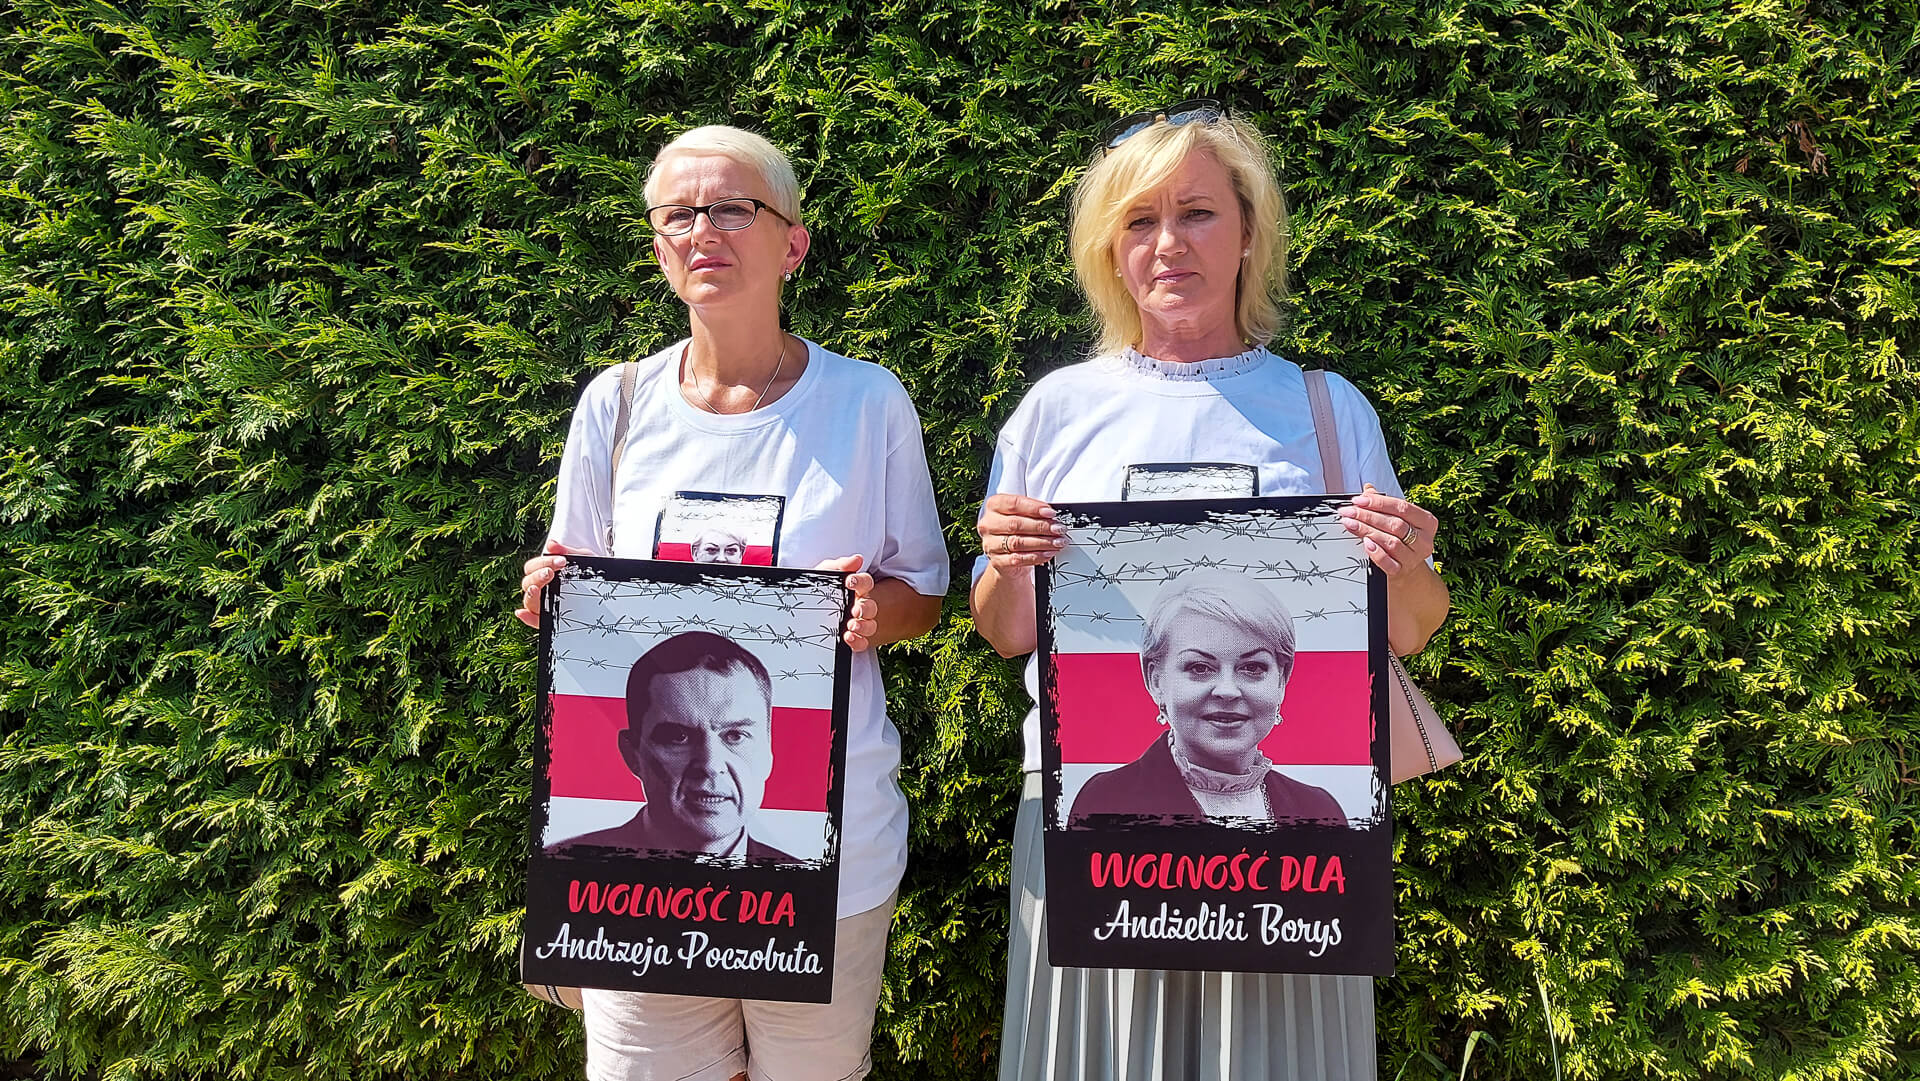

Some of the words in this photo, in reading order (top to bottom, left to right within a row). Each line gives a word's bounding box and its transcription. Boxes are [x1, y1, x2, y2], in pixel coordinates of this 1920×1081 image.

[1090, 848, 1270, 892] WOLNOŚĆ
[1279, 855, 1346, 894] DLA
[568, 880, 731, 922] WOLNOŚĆ
[738, 890, 796, 927] DLA
[1094, 900, 1249, 942] Andżeliki
[1252, 903, 1342, 957] Borys
[535, 922, 673, 976] Andrzeja
[677, 931, 824, 975] Poczobuta
